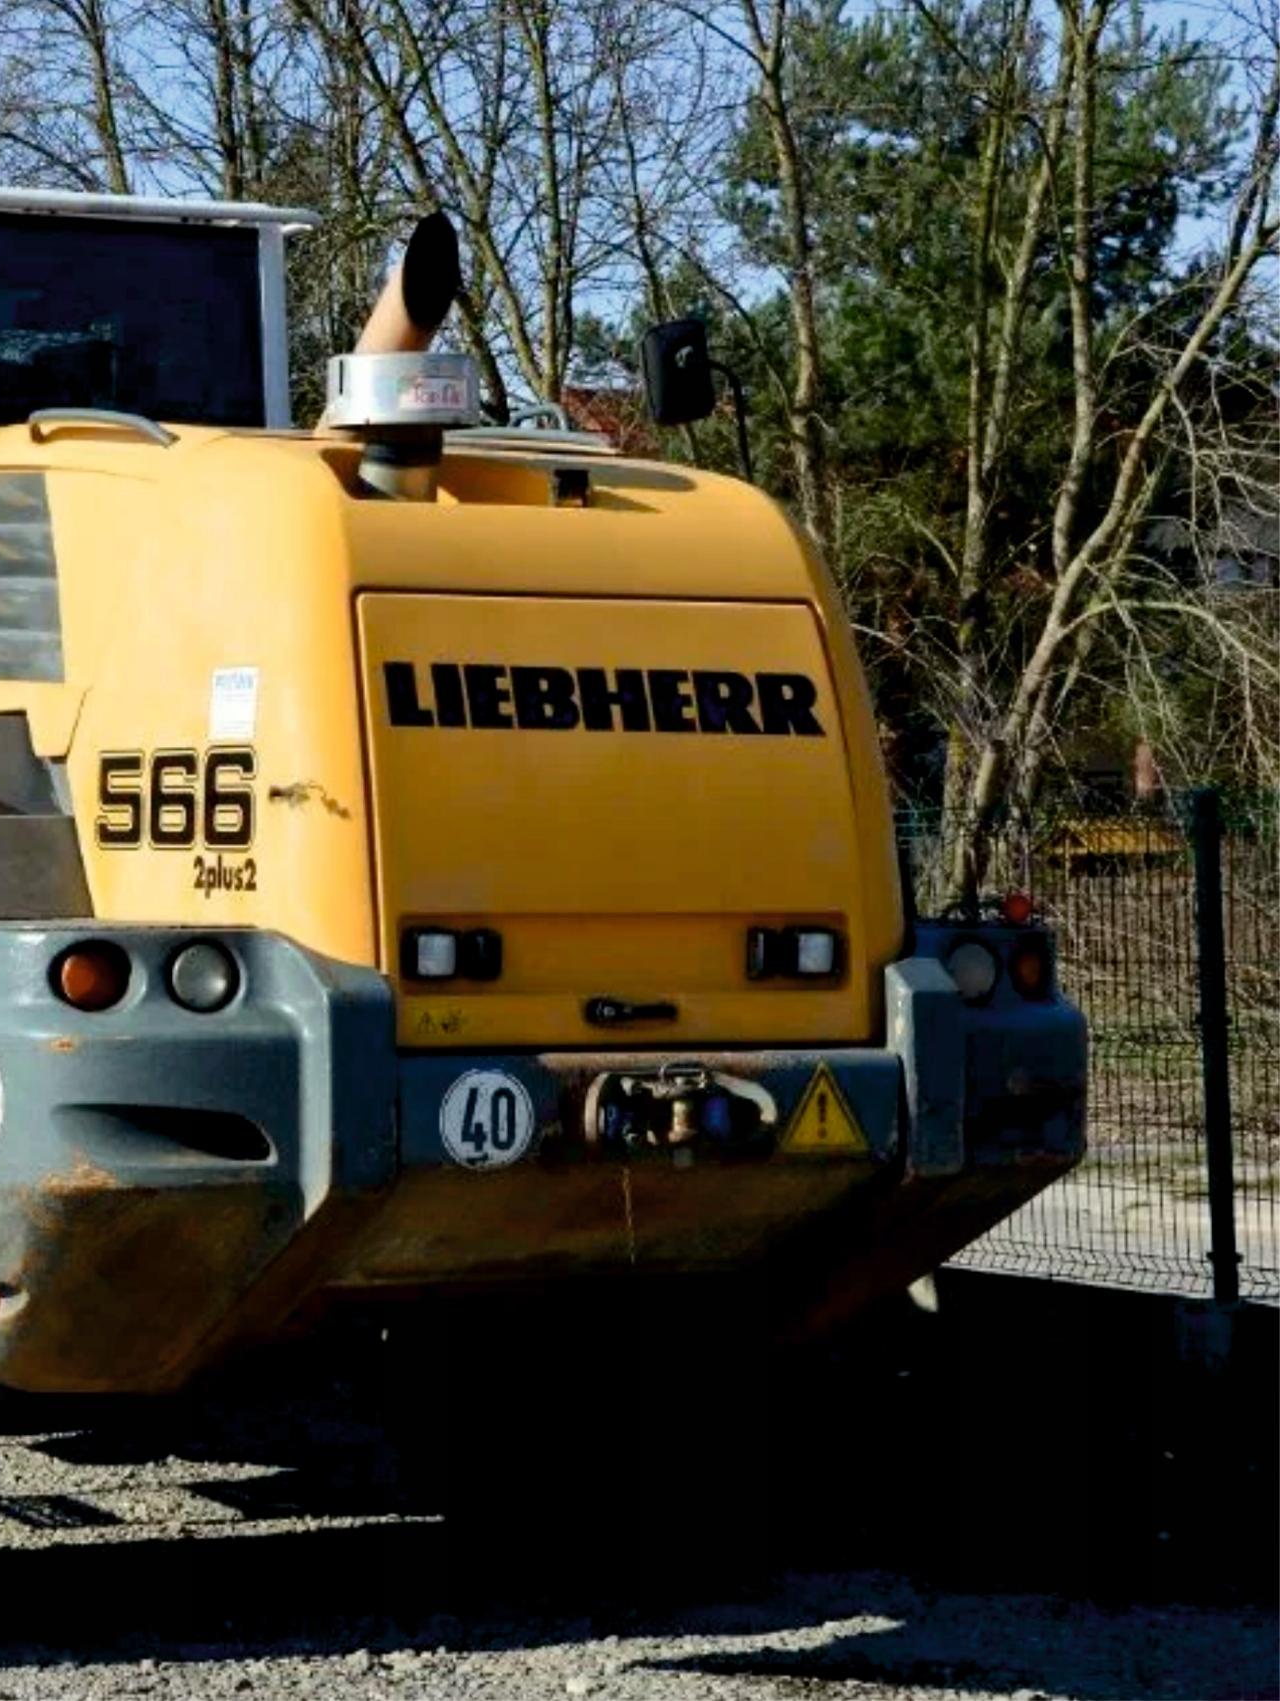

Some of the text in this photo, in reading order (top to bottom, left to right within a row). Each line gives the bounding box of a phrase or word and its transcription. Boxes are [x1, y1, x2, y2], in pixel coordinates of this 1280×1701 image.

[383, 661, 826, 737] LIEBHERR
[96, 745, 257, 852] 566
[193, 855, 257, 898] 2plus2
[461, 1087, 516, 1152] 40
